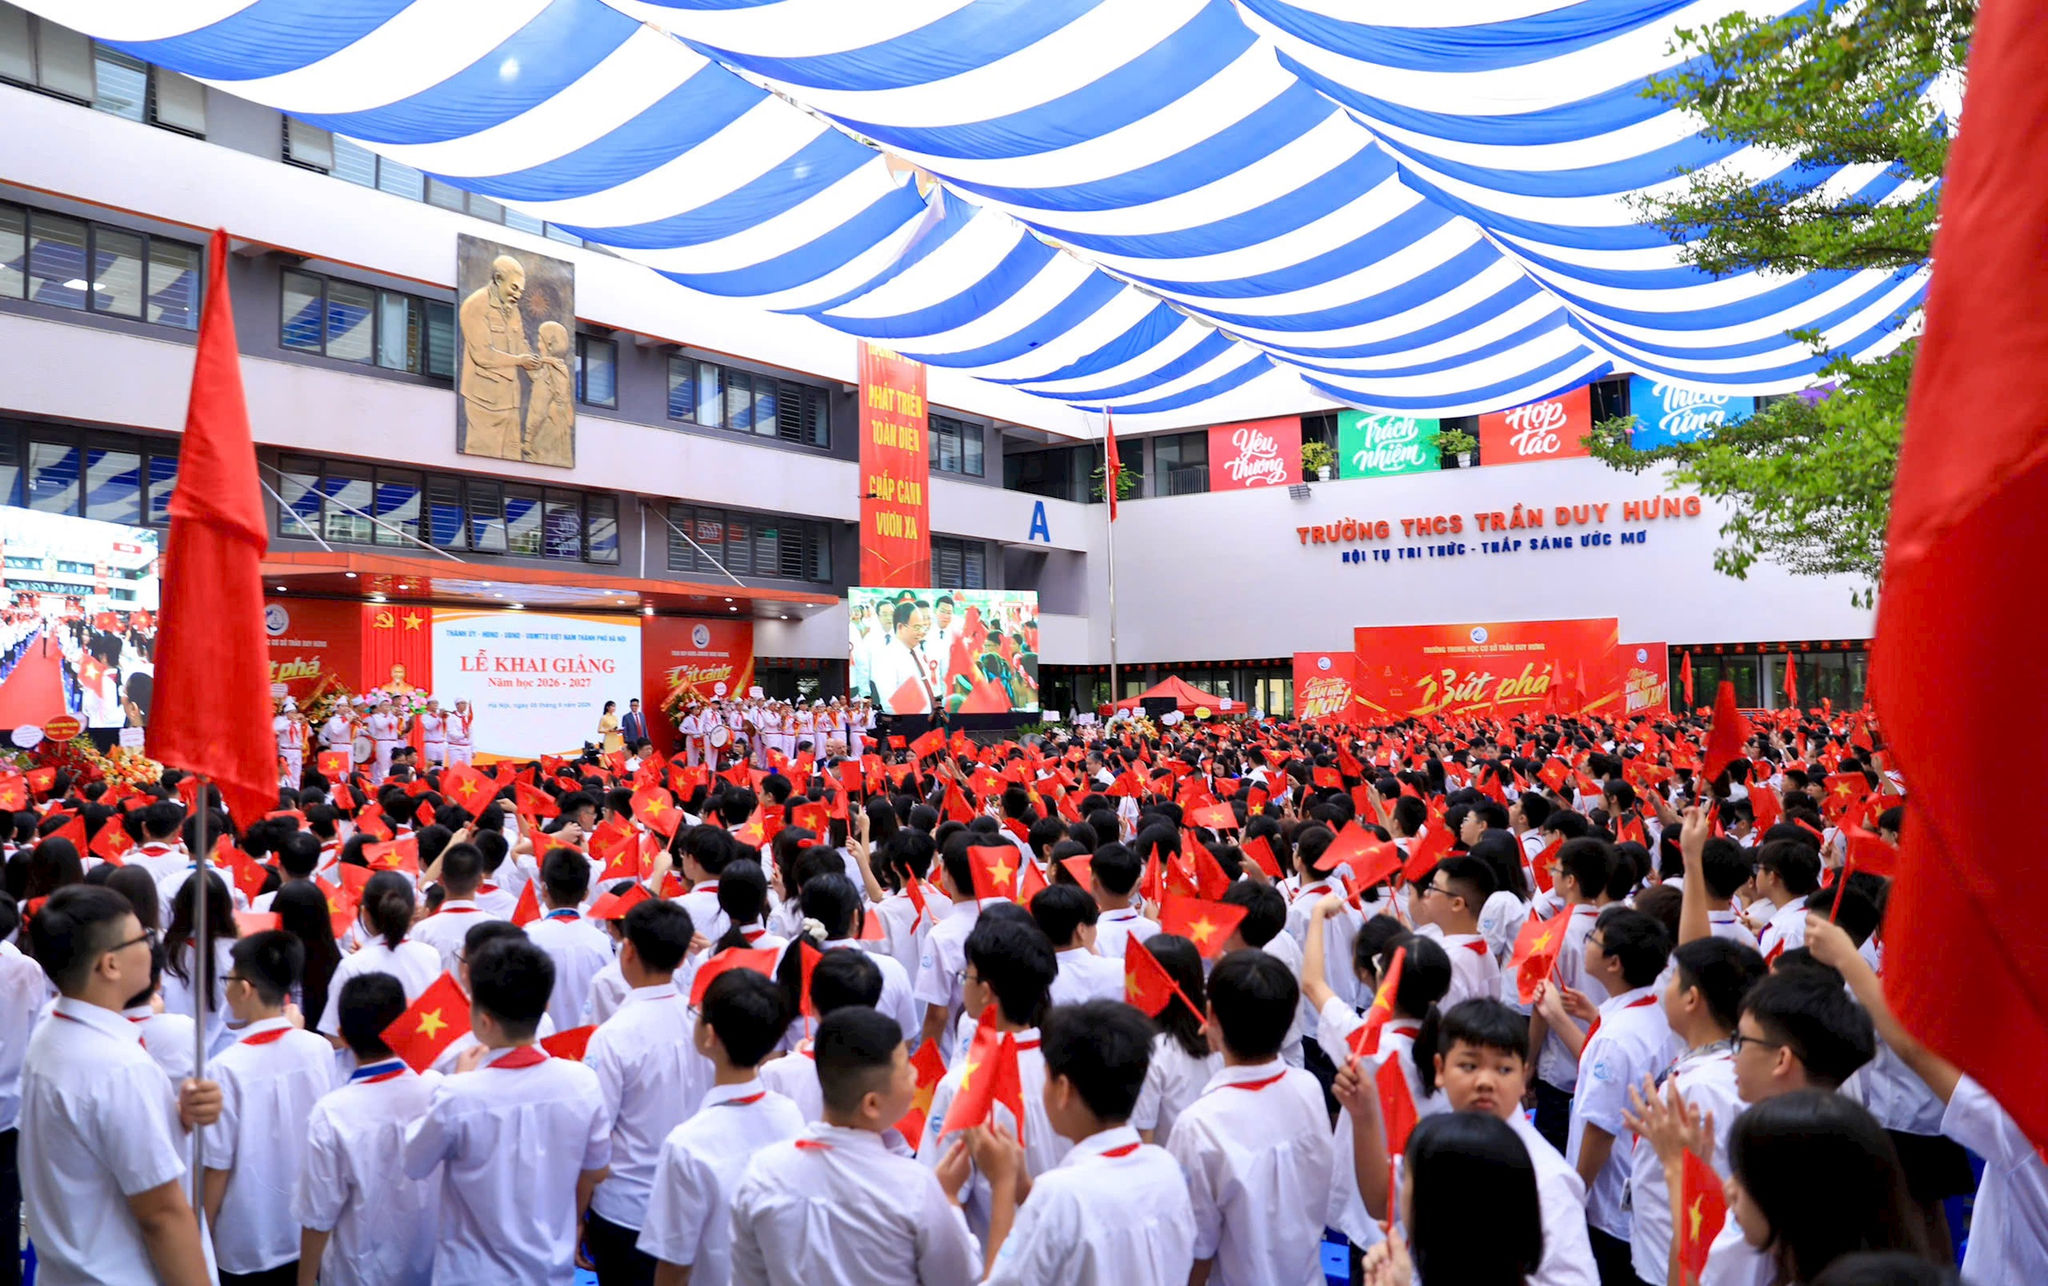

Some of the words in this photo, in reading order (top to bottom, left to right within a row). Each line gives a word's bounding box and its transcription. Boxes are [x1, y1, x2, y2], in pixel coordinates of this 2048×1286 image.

[868, 381, 894, 412] PHÁT
[896, 384, 923, 418] TRIỂN
[1356, 414, 1419, 449] Trách
[1504, 401, 1567, 433] Hợp
[871, 416, 897, 447] TOÀN
[899, 421, 920, 457] DIỆN
[1232, 428, 1278, 459] Yêu
[1224, 457, 1287, 487] thương
[1352, 441, 1426, 472] nhiệm
[870, 468, 895, 502] CHẮP
[897, 476, 922, 506] CÁNH
[876, 510, 903, 539] VƯƠN
[904, 515, 919, 540] XA
[1028, 500, 1050, 542] A
[1296, 517, 1390, 545] TRƯỜNG
[1400, 514, 1464, 538] THCS
[1474, 503, 1544, 532] TRẦN
[1555, 503, 1610, 526] DUY
[1623, 494, 1702, 522] HƯNG
[1342, 549, 1366, 564] HỘI
[1373, 549, 1390, 563] TỤ
[1397, 546, 1421, 560] TRI
[1427, 541, 1466, 557] THỨC
[1481, 536, 1522, 554] THẮP
[1529, 535, 1573, 551] SÁNG
[1581, 530, 1612, 547] ƯỚC
[1621, 529, 1647, 546] MƠ
[277, 655, 321, 683] phá
[460, 649, 489, 672] LỄ
[494, 656, 548, 673] KHAI
[552, 654, 616, 674] GIẢNG
[488, 677, 513, 687] Năm
[516, 677, 534, 689] học
[537, 677, 560, 687] 2026
[569, 677, 592, 688] 2027
[1493, 661, 1552, 702] phá
